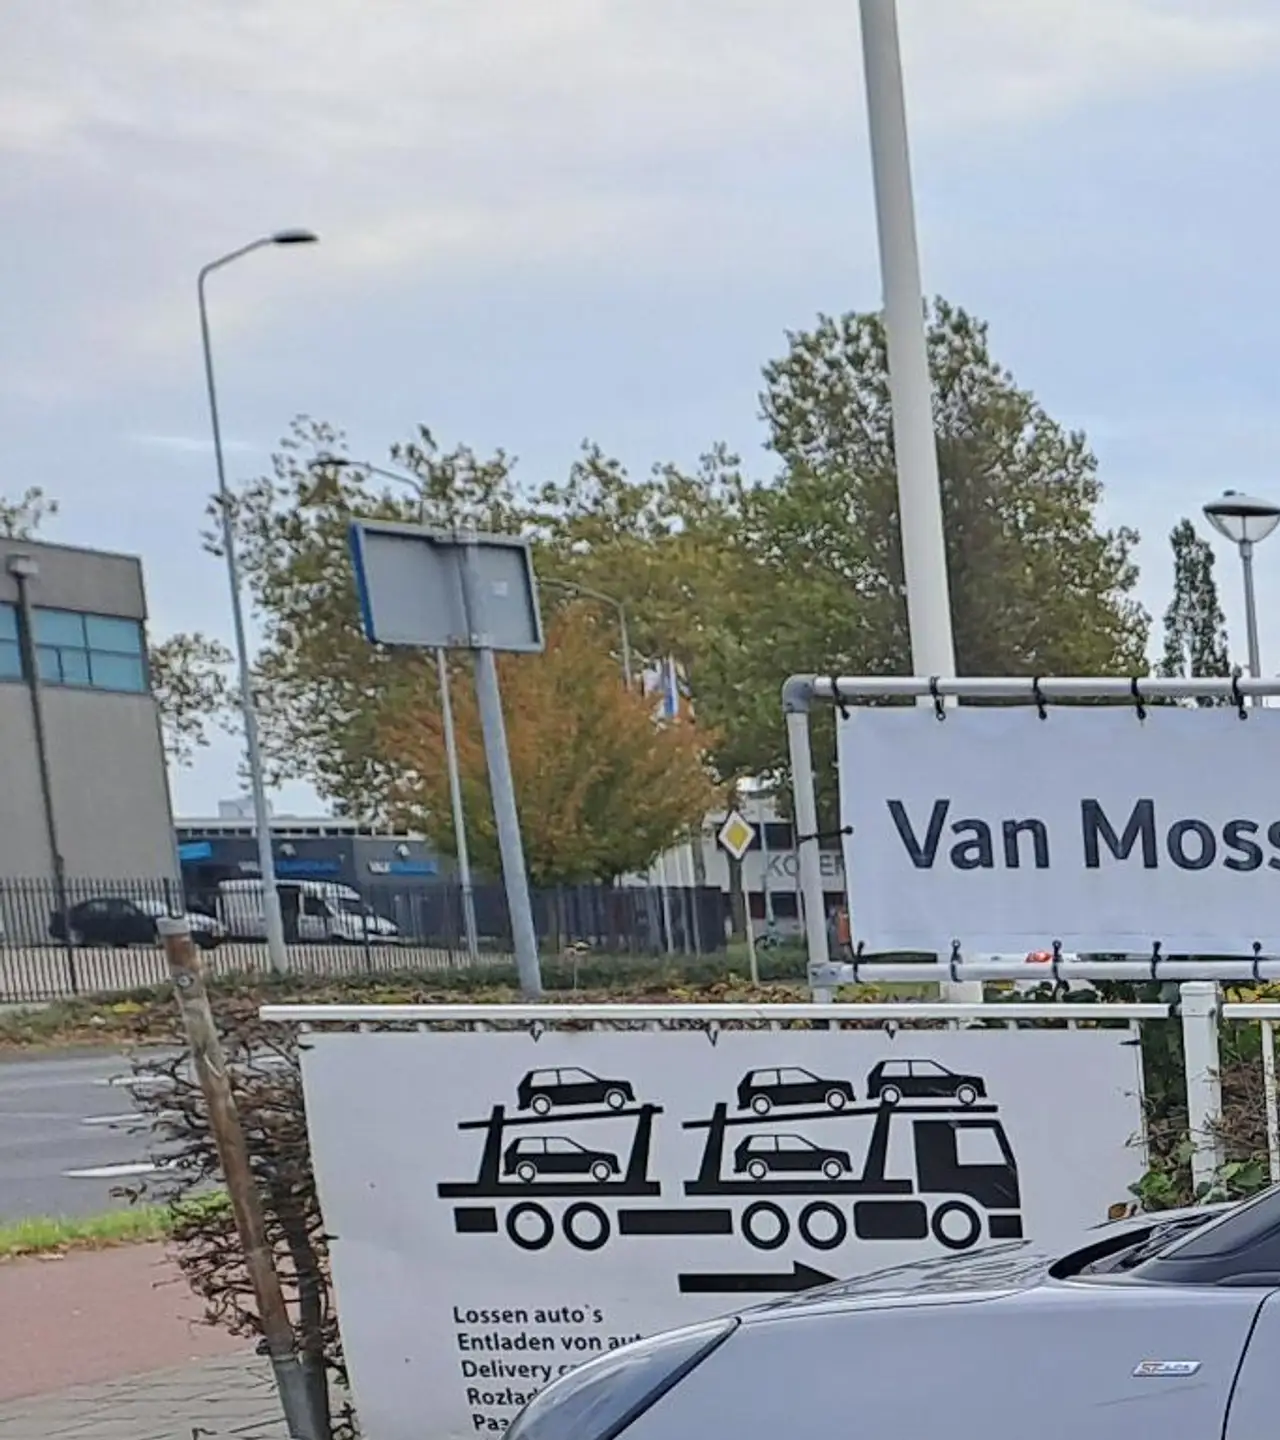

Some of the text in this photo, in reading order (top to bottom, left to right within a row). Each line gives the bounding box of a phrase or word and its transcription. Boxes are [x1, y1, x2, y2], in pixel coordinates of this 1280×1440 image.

[886, 799, 1050, 870] Van
[453, 1306, 528, 1323] Lossen
[458, 1332, 555, 1351] Entladen
[561, 1336, 602, 1351] von
[462, 1360, 552, 1382] Delivery
